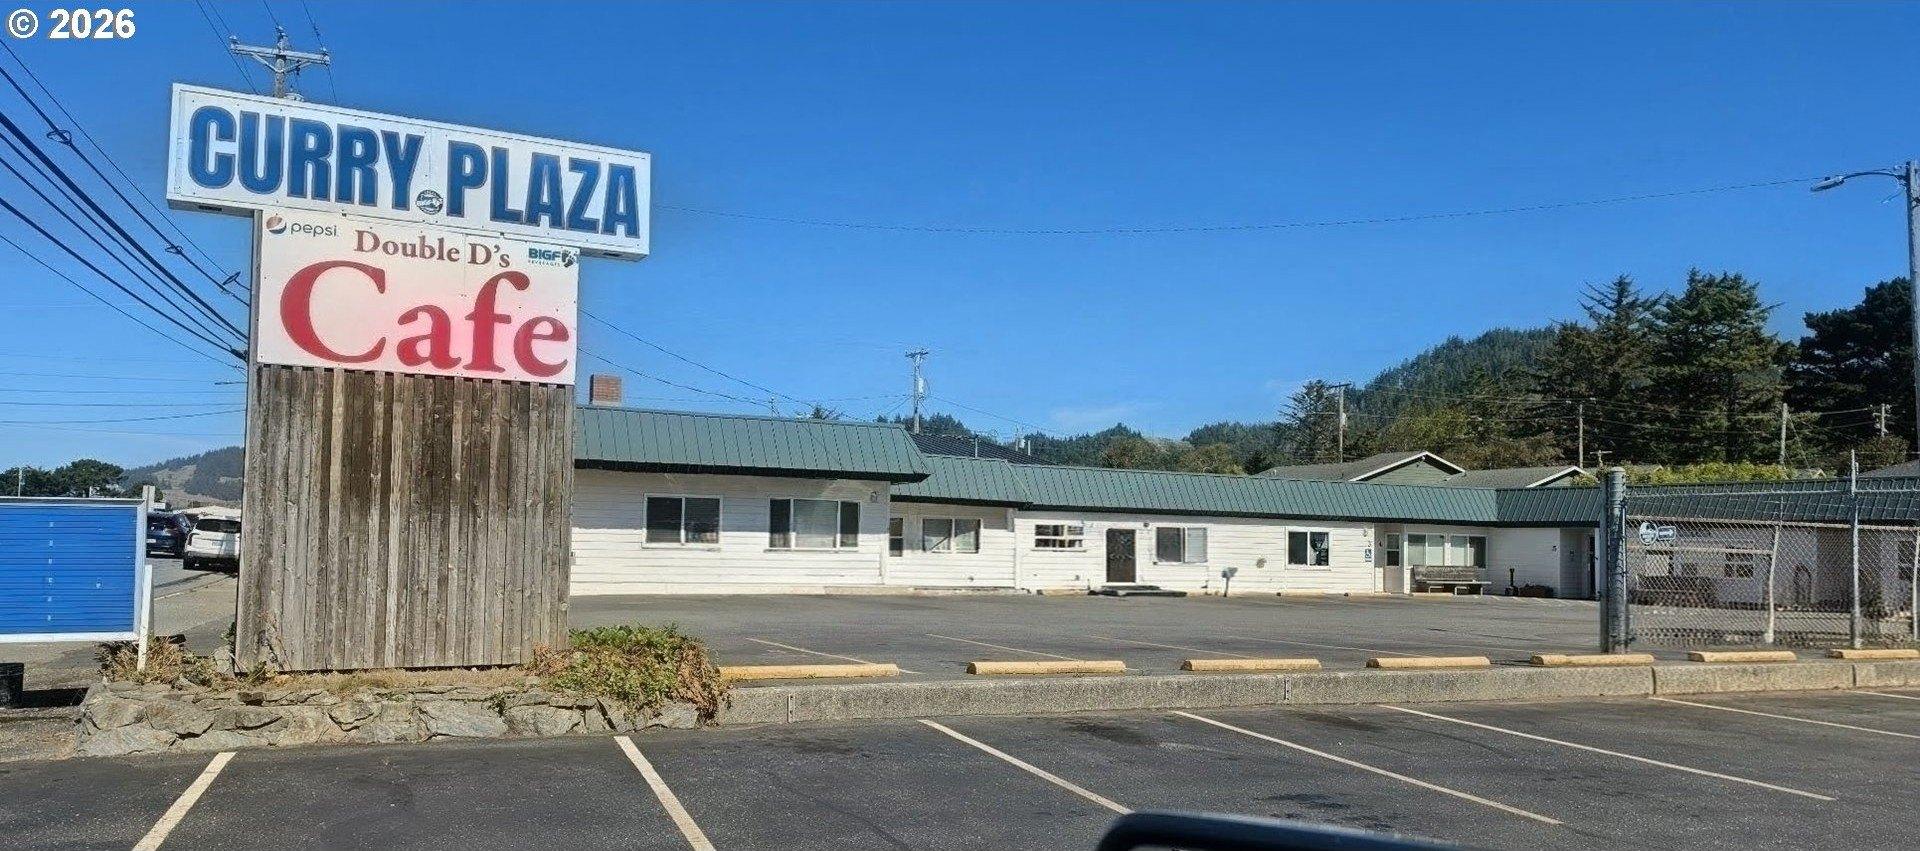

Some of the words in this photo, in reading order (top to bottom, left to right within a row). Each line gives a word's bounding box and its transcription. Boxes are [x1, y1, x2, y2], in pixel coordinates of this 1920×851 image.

[188, 105, 425, 211] CURRY
[446, 140, 641, 239] PLAZA
[290, 222, 337, 238] pepsi
[354, 229, 460, 262] Double
[280, 260, 570, 378] Cafe
